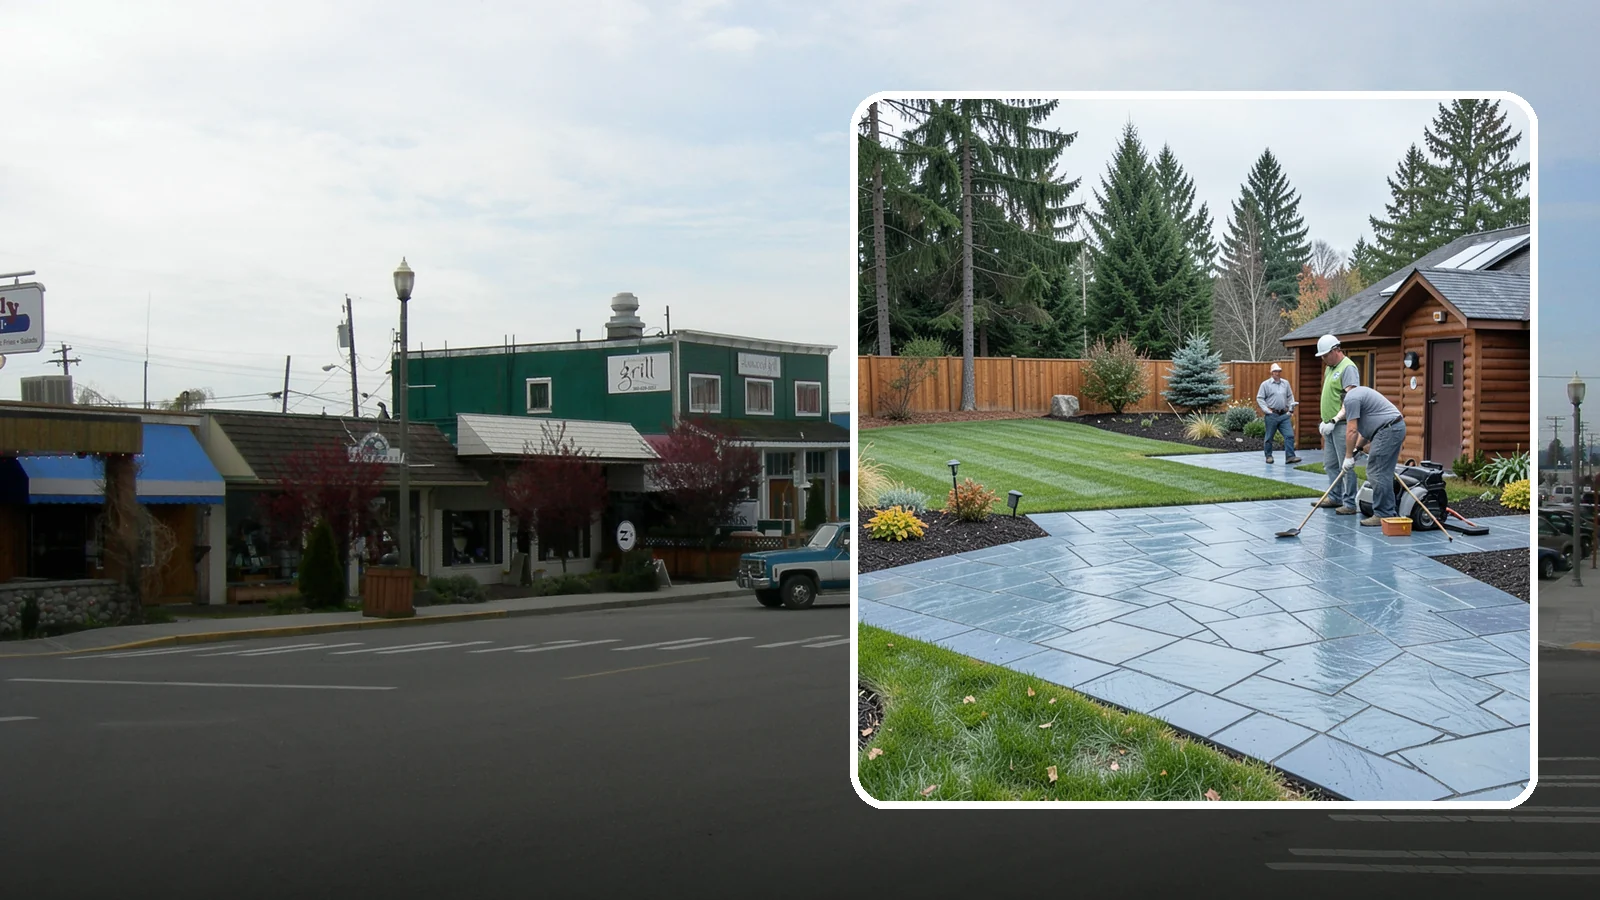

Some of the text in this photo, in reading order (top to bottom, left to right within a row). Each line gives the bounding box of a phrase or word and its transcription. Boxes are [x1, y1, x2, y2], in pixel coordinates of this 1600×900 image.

[3, 338, 15, 346] Fries
[20, 337, 37, 345] Salads
[618, 356, 654, 392] grill
